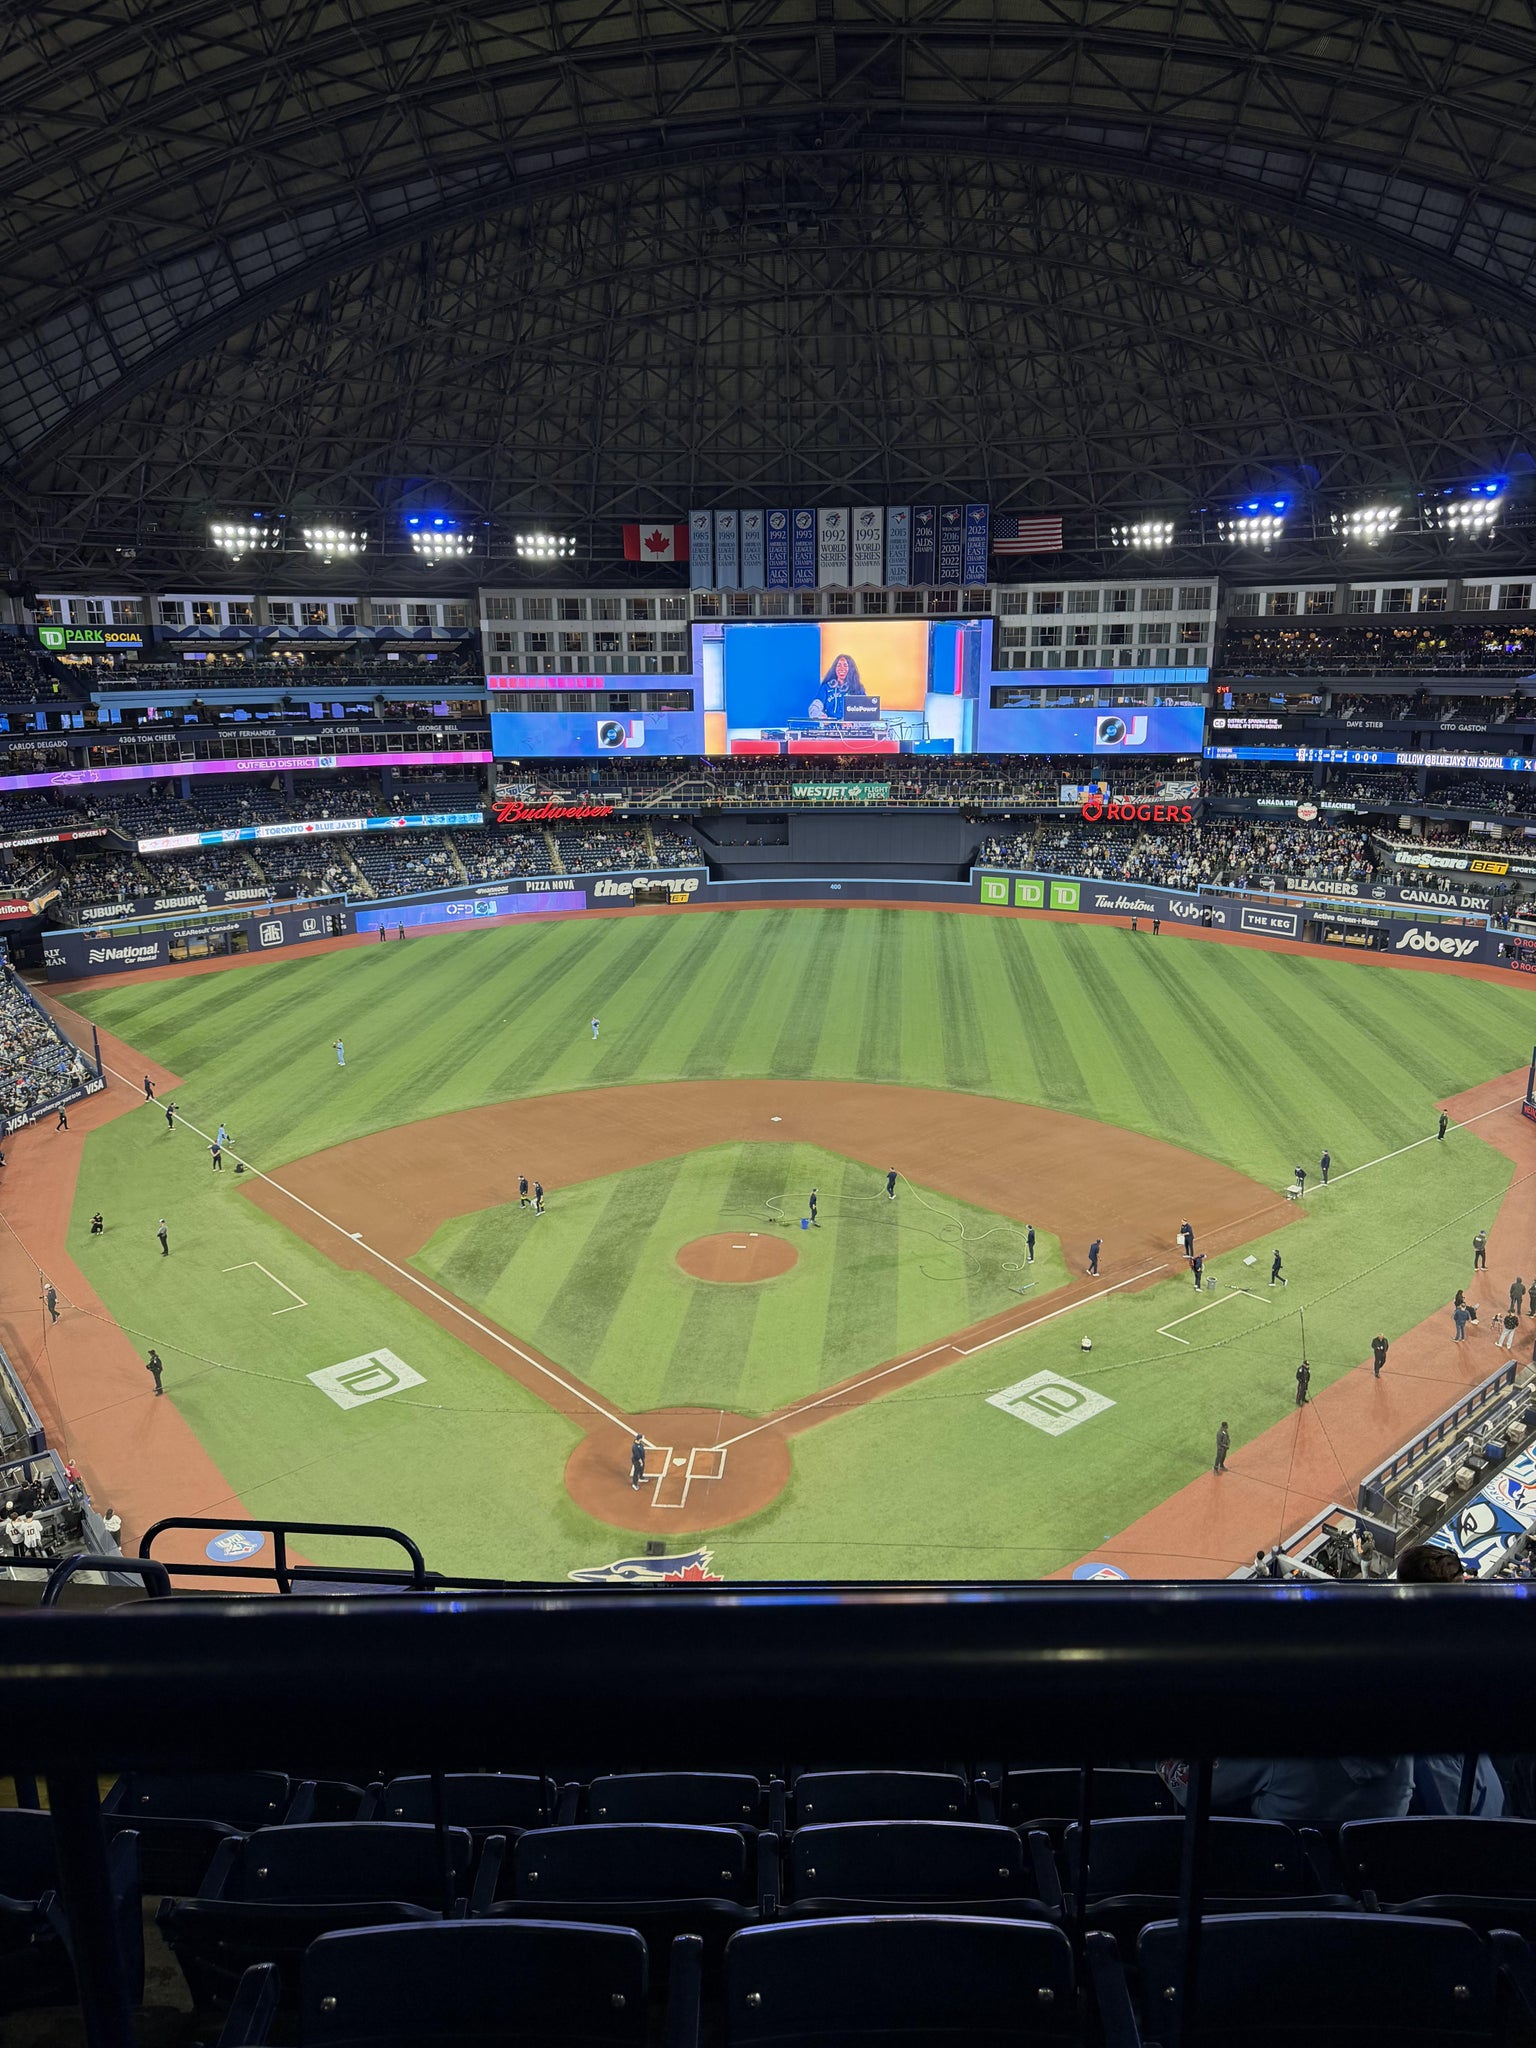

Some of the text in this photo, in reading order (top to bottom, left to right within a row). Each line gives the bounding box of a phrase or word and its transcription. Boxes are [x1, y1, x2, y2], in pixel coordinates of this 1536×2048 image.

[693, 531, 709, 540] 1985
[718, 531, 735, 540] 1989
[744, 531, 760, 540] 1991
[770, 530, 786, 540] 1992
[796, 530, 812, 539] 1993
[822, 529, 846, 542] 1992
[856, 528, 880, 541] 1993
[890, 528, 906, 537] 2015
[916, 527, 933, 536] 2016
[968, 526, 986, 535] 2025
[915, 538, 933, 546] ALDS
[942, 532, 959, 541] 2016
[820, 544, 846, 552] WORLD
[854, 543, 880, 552] WORLD
[941, 545, 960, 553] 2020
[820, 553, 846, 561] SERIES
[854, 552, 880, 561] SERIES
[941, 557, 959, 565] 2022
[890, 567, 907, 575] ALDS
[941, 569, 959, 578] 2023
[967, 565, 985, 574] ALCS
[41, 630, 142, 646] TD PARK SOCIAL
[239, 729, 276, 737] FERNANDEZ
[118, 734, 176, 744] 4306 TOM CHEEK
[8, 740, 68, 751] CARLOS DELGADO
[237, 760, 277, 770] OUTFIELD
[278, 759, 316, 767] DISTRICT
[1396, 754, 1504, 768] FOLLOW @BLUEJAYS ON SOCIAL
[793, 786, 848, 799] WESTJET
[491, 801, 613, 823] Budweiser
[1107, 803, 1192, 823] ROGERS
[78, 830, 99, 838] ROGERS
[264, 821, 356, 836] TORONTO BLUE JAYS
[12, 837, 42, 847] CANADA'S
[1395, 852, 1468, 870] theScore
[1472, 862, 1507, 874] BET
[526, 880, 575, 892] PIZZA NOVA
[984, 882, 1006, 899] TD
[1286, 878, 1359, 896] BLEACHERS
[1018, 884, 1041, 902] TD
[1054, 887, 1077, 905] TD
[1400, 889, 1458, 907] CANADA
[153, 894, 207, 911] SUBWAY
[1094, 895, 1155, 912] Tim Hortons
[81, 903, 136, 921] SUBWAY
[446, 904, 474, 915] OFD
[1169, 900, 1226, 924] Kubota
[1248, 915, 1290, 929] THE KEG
[1313, 912, 1335, 921] Active
[173, 927, 209, 938] CLEAResult
[1396, 928, 1479, 957] Sobeys
[84, 1079, 104, 1095] VISA
[6, 1113, 29, 1131] VISA
[1006, 1383, 1087, 1418] TD
[26, 1528, 35, 1536] 10
